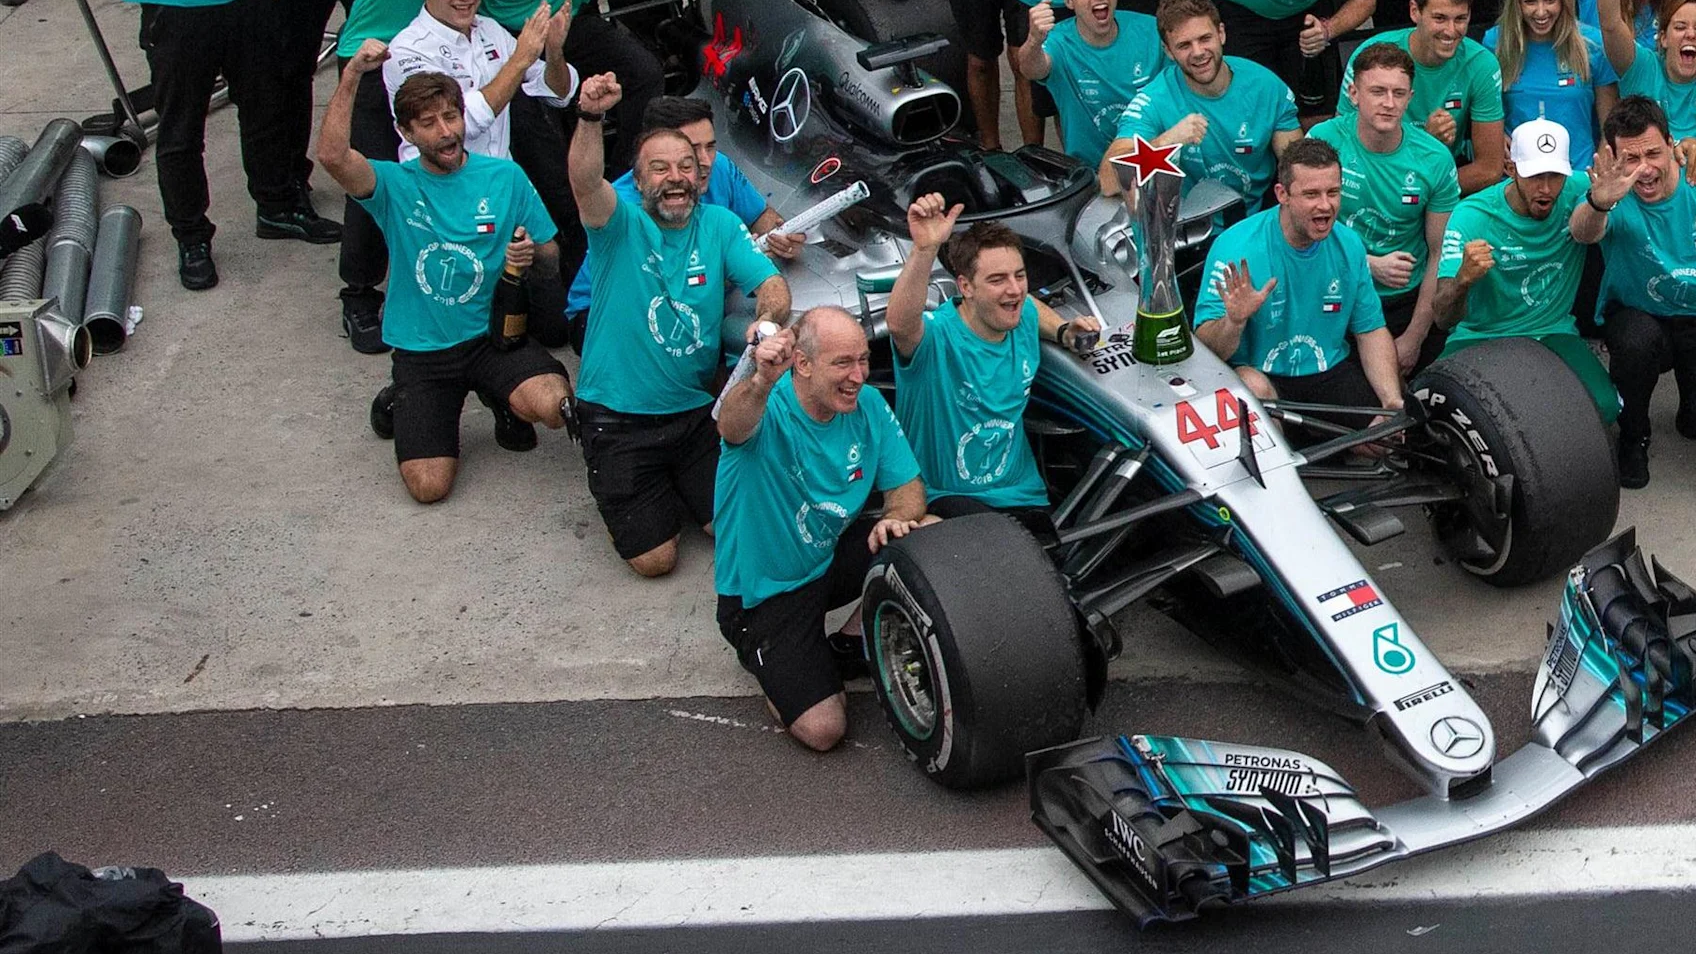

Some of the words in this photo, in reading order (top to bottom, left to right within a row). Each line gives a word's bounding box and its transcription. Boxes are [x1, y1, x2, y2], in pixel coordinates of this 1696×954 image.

[398, 55, 422, 67] EPSON
[839, 71, 881, 117] Qualcomm
[1209, 162, 1244, 177] WINNERS
[1345, 180, 1361, 190] UBS
[440, 242, 476, 260] WINNERS
[1510, 253, 1527, 262] UBS
[440, 257, 456, 291] 1
[433, 293, 456, 306] 2018
[1079, 338, 1134, 362] PETRO
[1091, 352, 1137, 374] SYN
[983, 419, 1015, 430] WINNER
[1174, 387, 1260, 450] 44
[1430, 393, 1446, 407] P
[1451, 408, 1500, 478] ZER
[969, 474, 993, 486] 2018
[811, 501, 847, 518] WINNERS
[1320, 581, 1366, 601] TOMMY
[1334, 600, 1382, 621] HILFIGER
[1393, 681, 1455, 712] PIRELLI
[1224, 753, 1301, 770] PETRONAS
[1225, 769, 1302, 794] SYNTIUM
[1110, 810, 1146, 862] IWC
